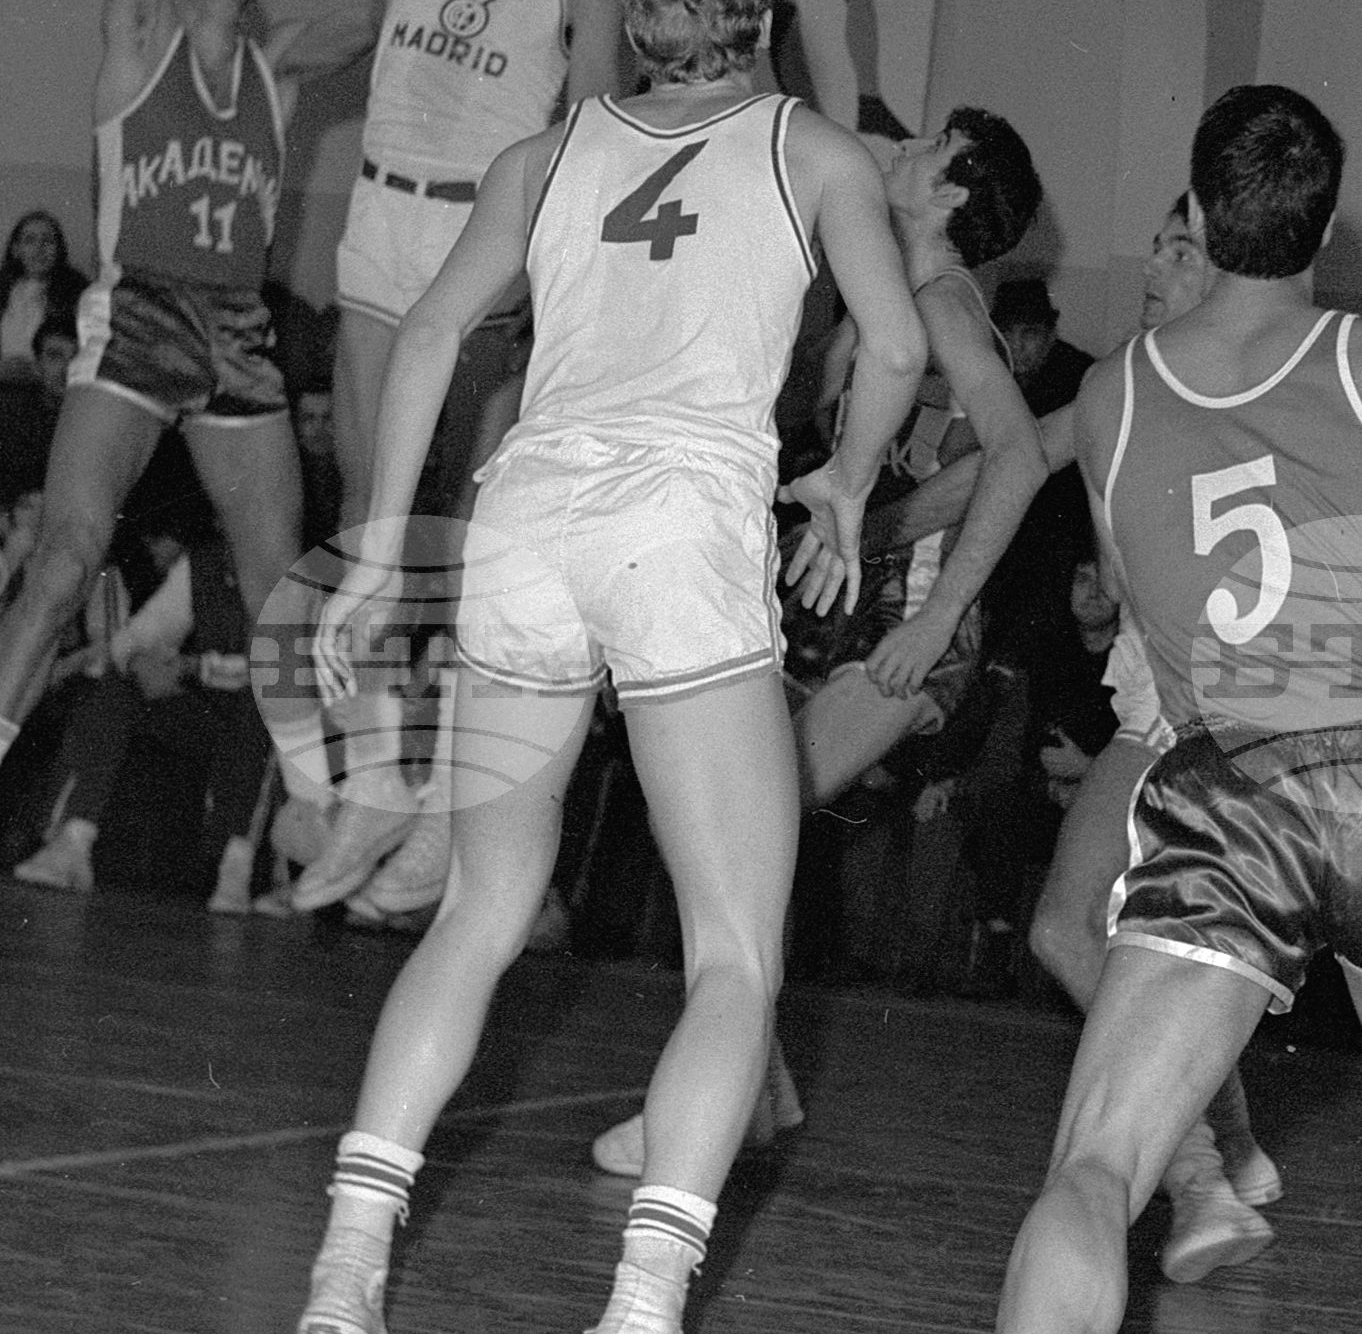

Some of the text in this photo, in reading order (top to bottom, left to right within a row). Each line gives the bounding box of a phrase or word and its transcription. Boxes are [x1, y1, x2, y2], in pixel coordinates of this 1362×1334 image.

[391, 22, 508, 77] MADRID
[189, 194, 237, 253] 11
[600, 139, 709, 262] 4
[1191, 454, 1292, 645] 5
